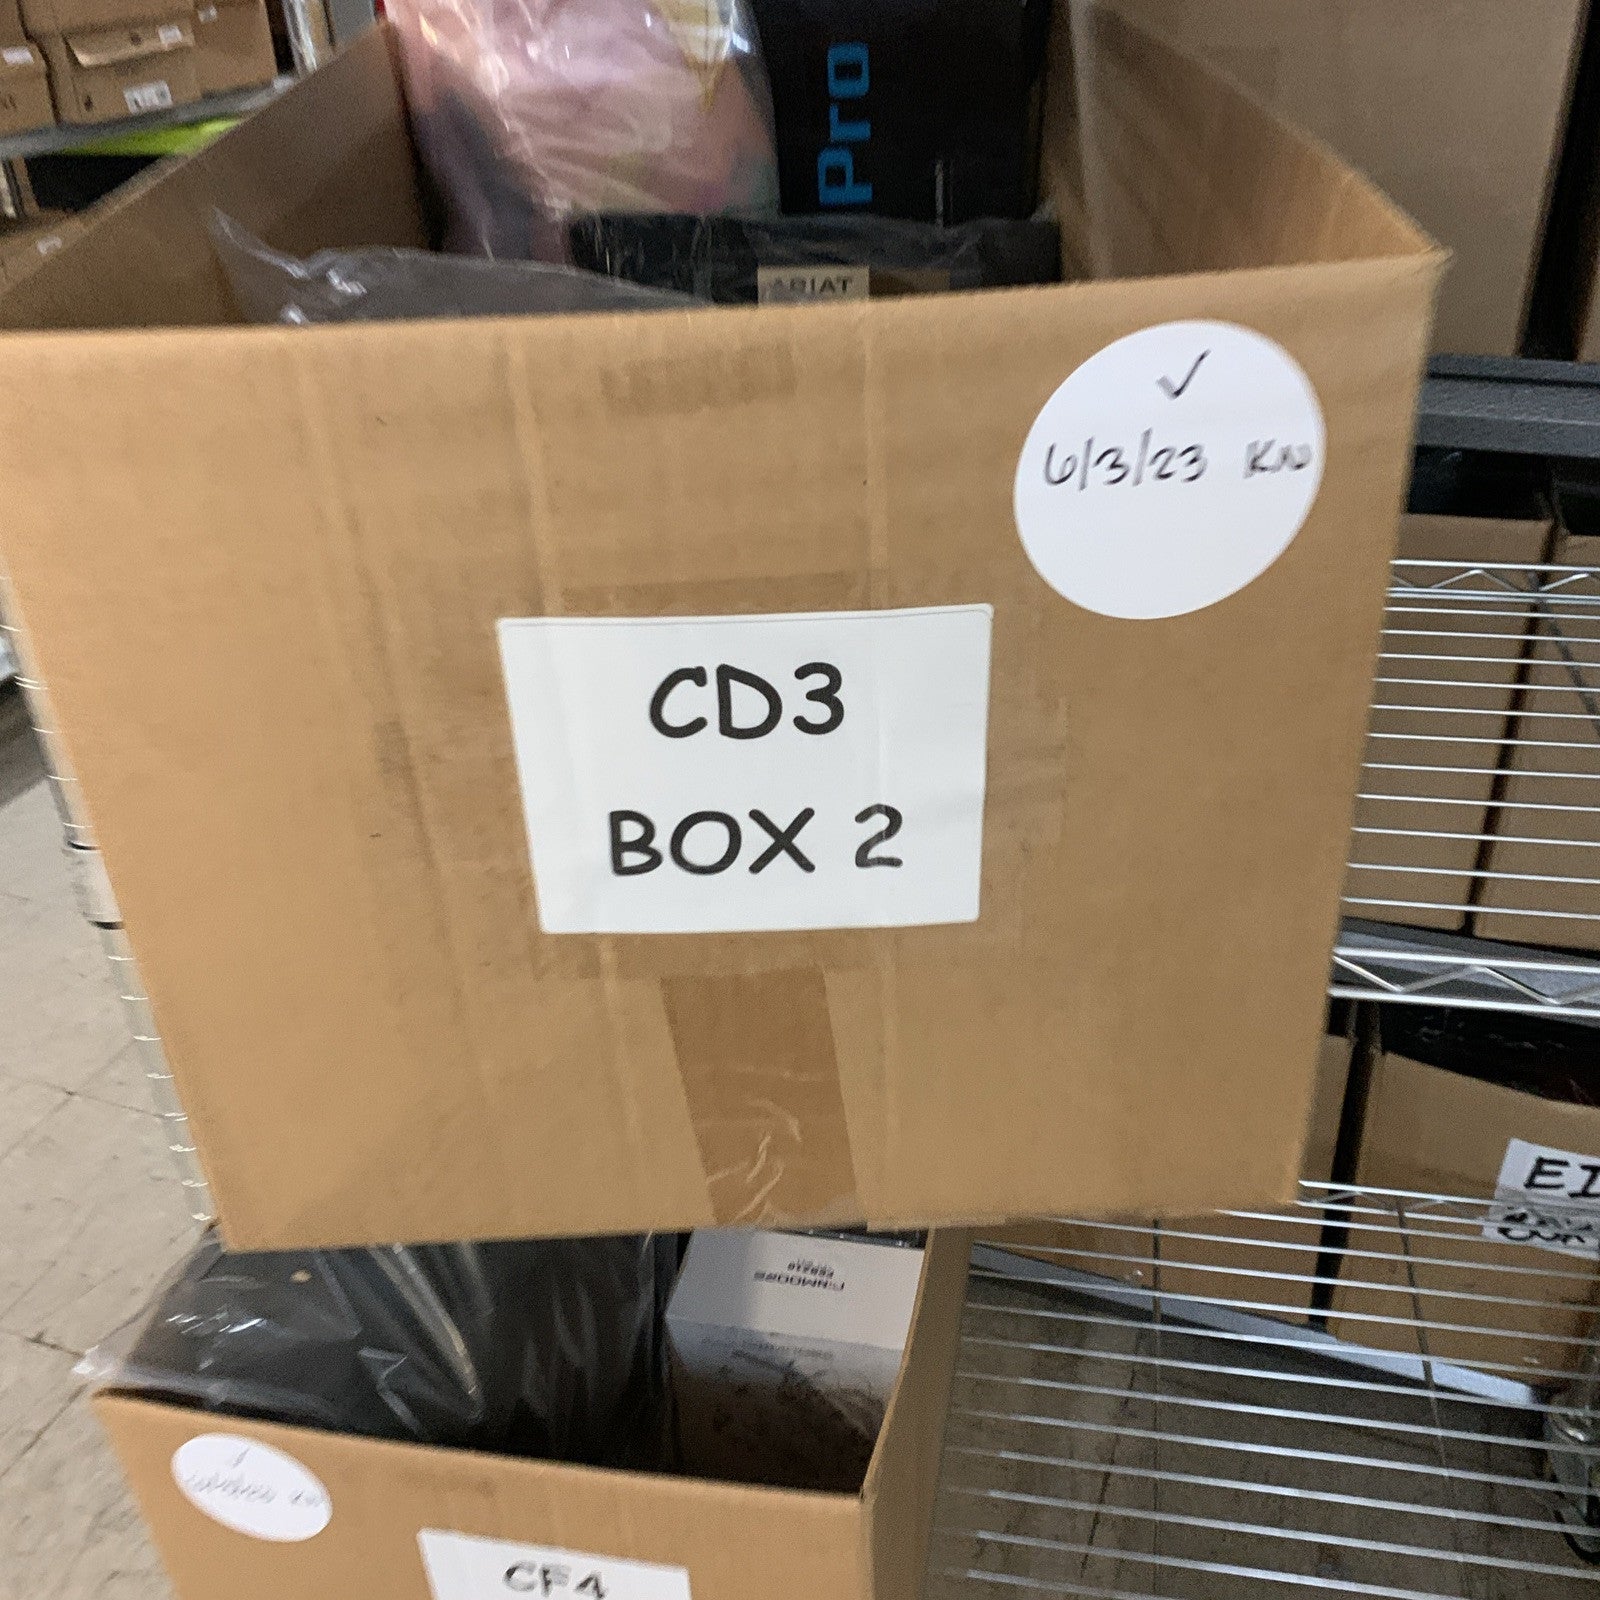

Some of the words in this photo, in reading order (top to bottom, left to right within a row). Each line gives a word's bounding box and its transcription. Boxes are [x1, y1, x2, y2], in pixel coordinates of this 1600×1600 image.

[818, 43, 872, 205] Pro
[1043, 428, 1208, 491] 6/3/23
[649, 661, 845, 739] CD3
[609, 808, 815, 876] BOX
[855, 804, 903, 868] 2
[502, 1560, 608, 1600] CF4
